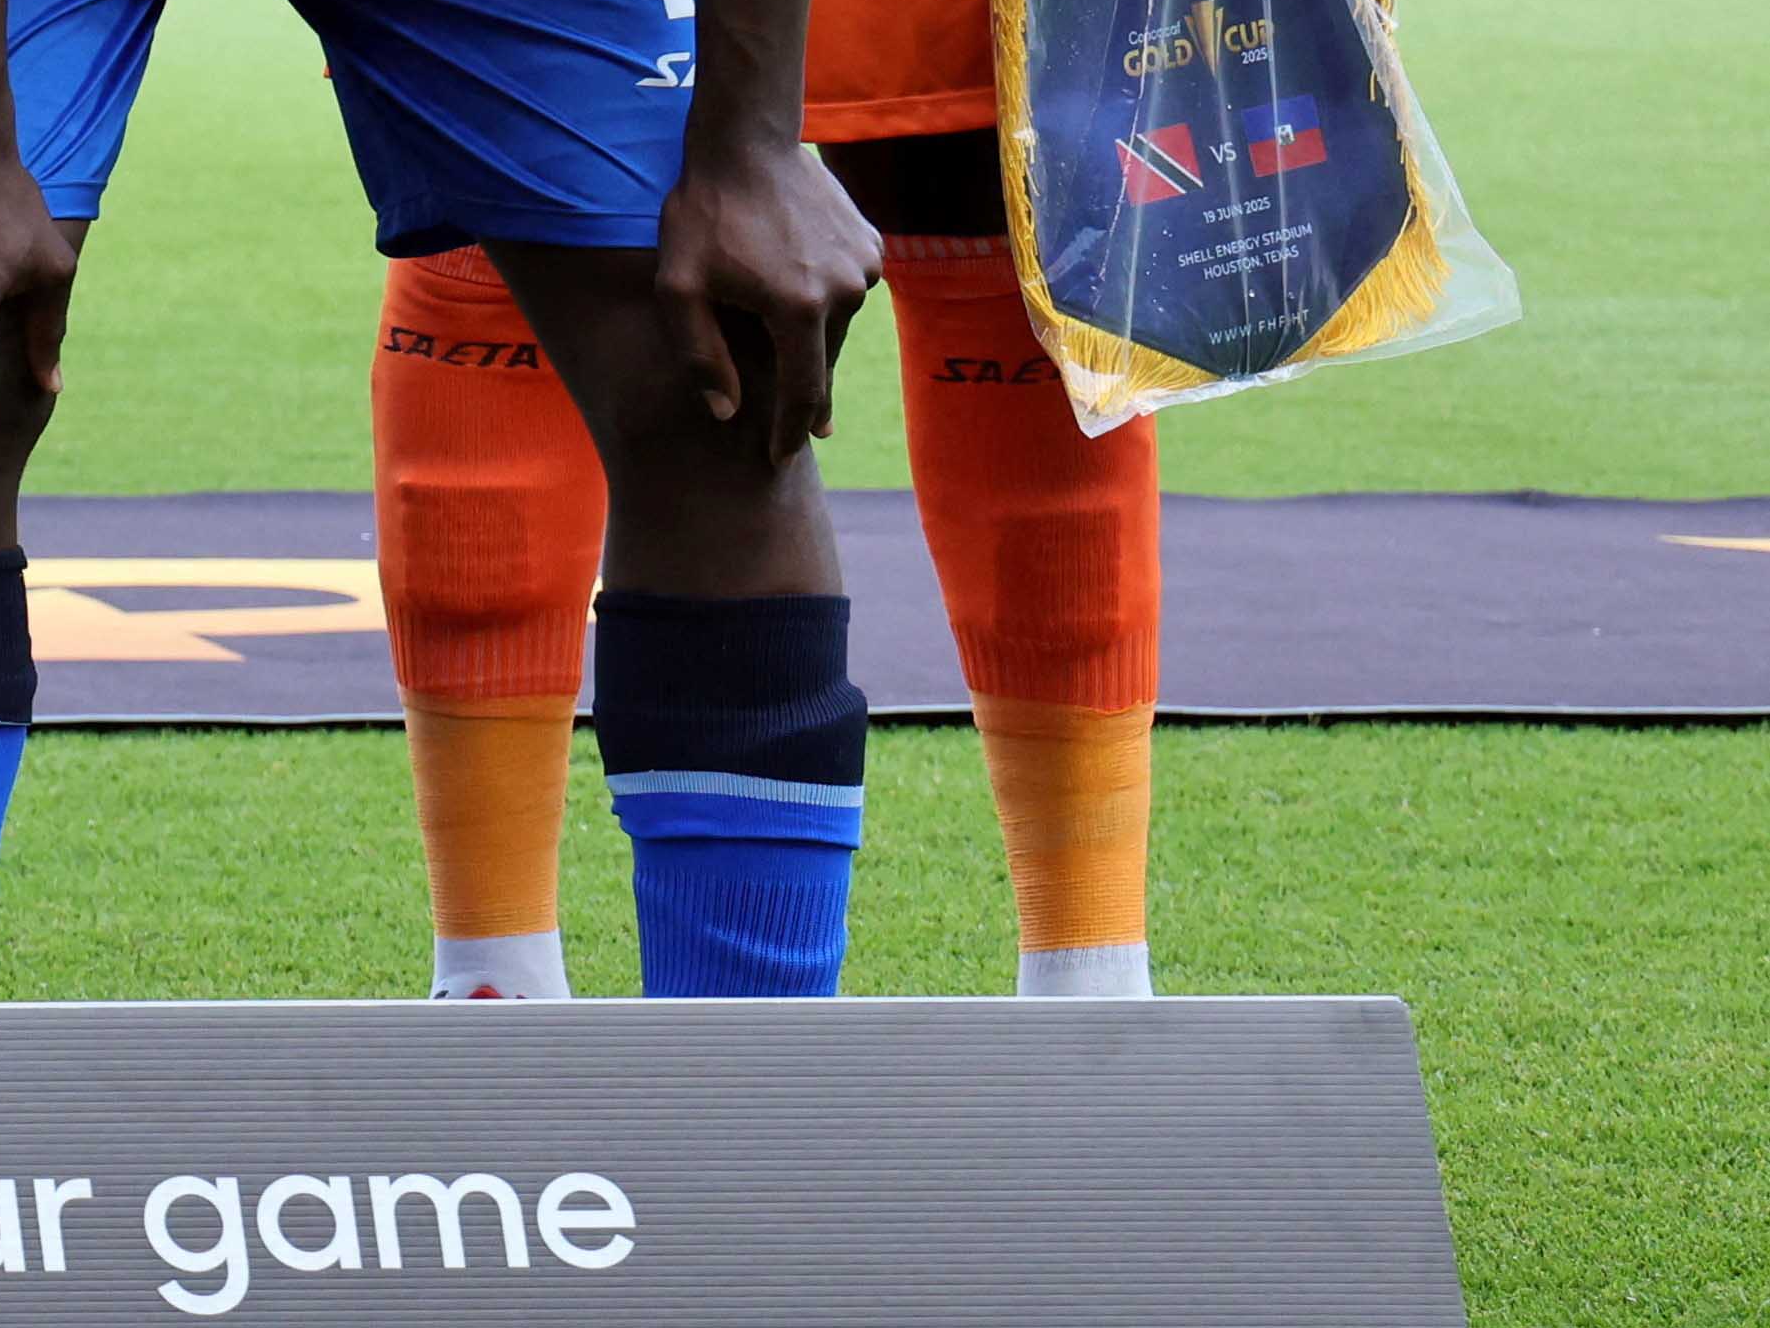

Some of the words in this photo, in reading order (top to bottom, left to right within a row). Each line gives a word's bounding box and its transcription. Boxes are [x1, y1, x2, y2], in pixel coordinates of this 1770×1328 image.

[1123, 38, 1193, 77] GOLD
[1241, 47, 1268, 64] 2025
[1209, 142, 1237, 163] VS
[1203, 211, 1216, 224] 19
[1244, 197, 1271, 215] 2025
[1178, 248, 1215, 267] SHELL
[1215, 236, 1260, 259] ENERGY
[1262, 222, 1313, 245] STADIUM
[1264, 245, 1300, 264] TEXAS
[382, 326, 539, 369] SAETA
[932, 356, 1060, 384] SAE
[143, 1171, 636, 1316] game
